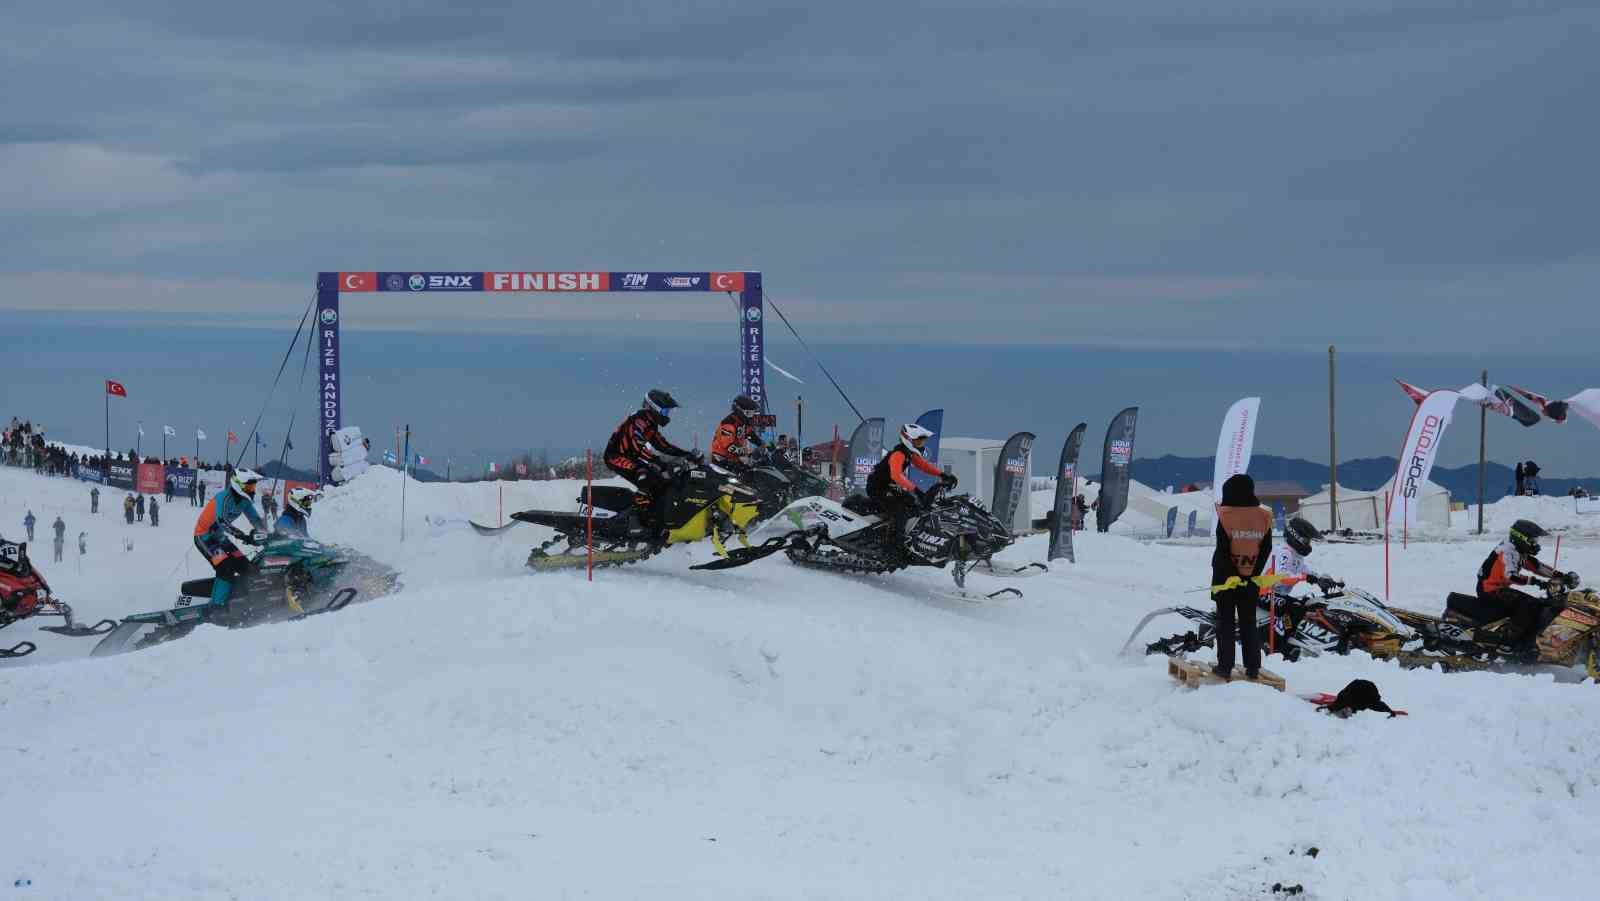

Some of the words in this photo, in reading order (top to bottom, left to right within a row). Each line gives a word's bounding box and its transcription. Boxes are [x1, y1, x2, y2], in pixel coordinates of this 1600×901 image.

[429, 275, 472, 287] SNX
[494, 273, 599, 290] FINISH
[623, 273, 649, 286] FIM
[324, 330, 335, 366] RIZE
[750, 327, 759, 361] RIZE
[110, 465, 133, 476] SNX
[1440, 624, 1462, 637] 26
